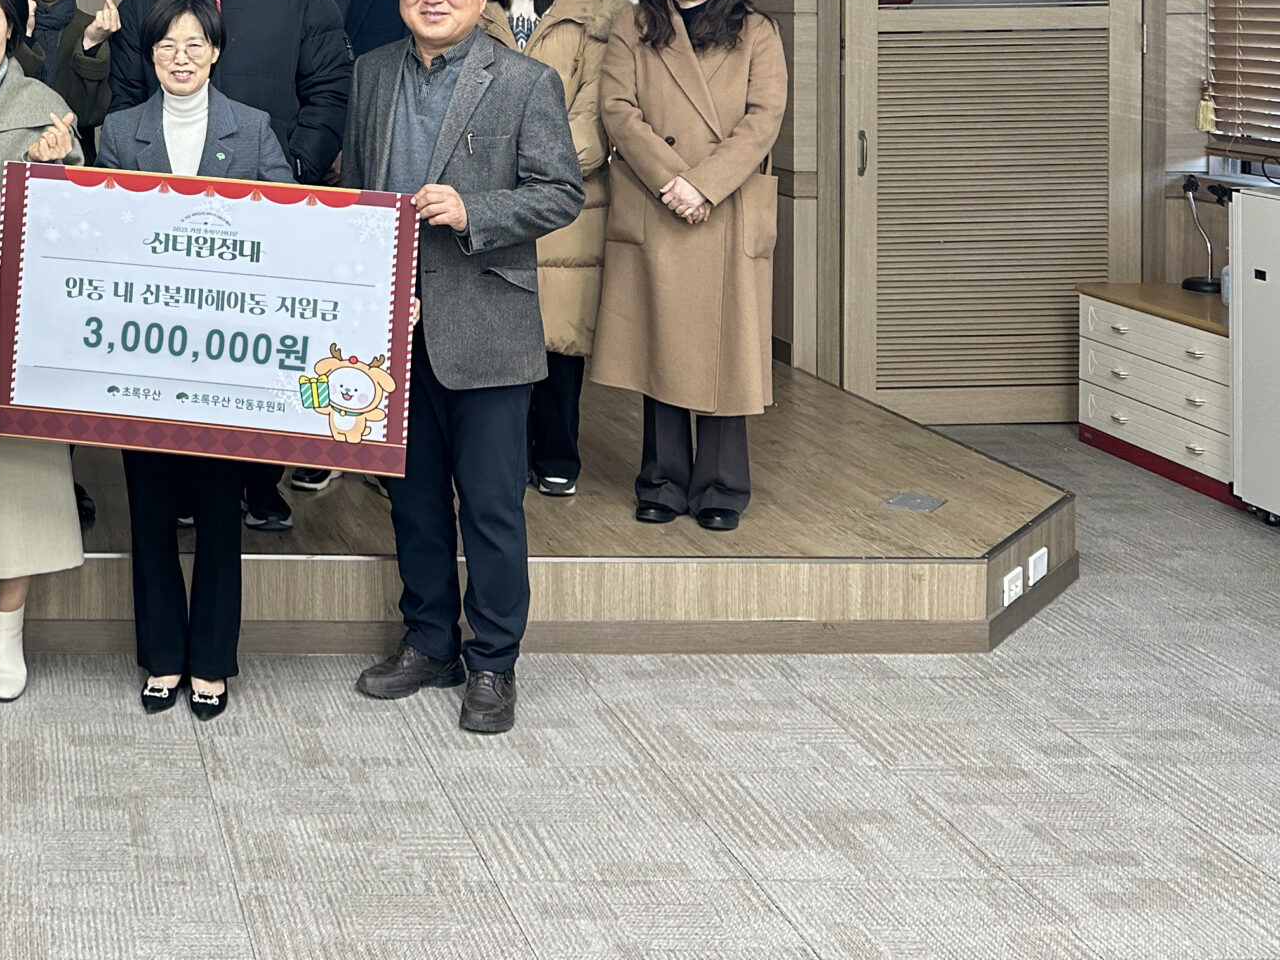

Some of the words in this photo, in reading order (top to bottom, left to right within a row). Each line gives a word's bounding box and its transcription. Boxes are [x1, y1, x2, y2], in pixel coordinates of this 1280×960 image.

[145, 231, 264, 263] 산타원정대
[65, 277, 106, 301] 안동
[113, 281, 134, 303] 내
[140, 284, 268, 316] 산불피해아동
[275, 295, 341, 322] 지원금
[83, 316, 309, 372] 3,000,000원
[122, 386, 161, 401] 초록우산
[191, 393, 231, 408] 초록우산
[235, 397, 286, 413] 안동후원회
